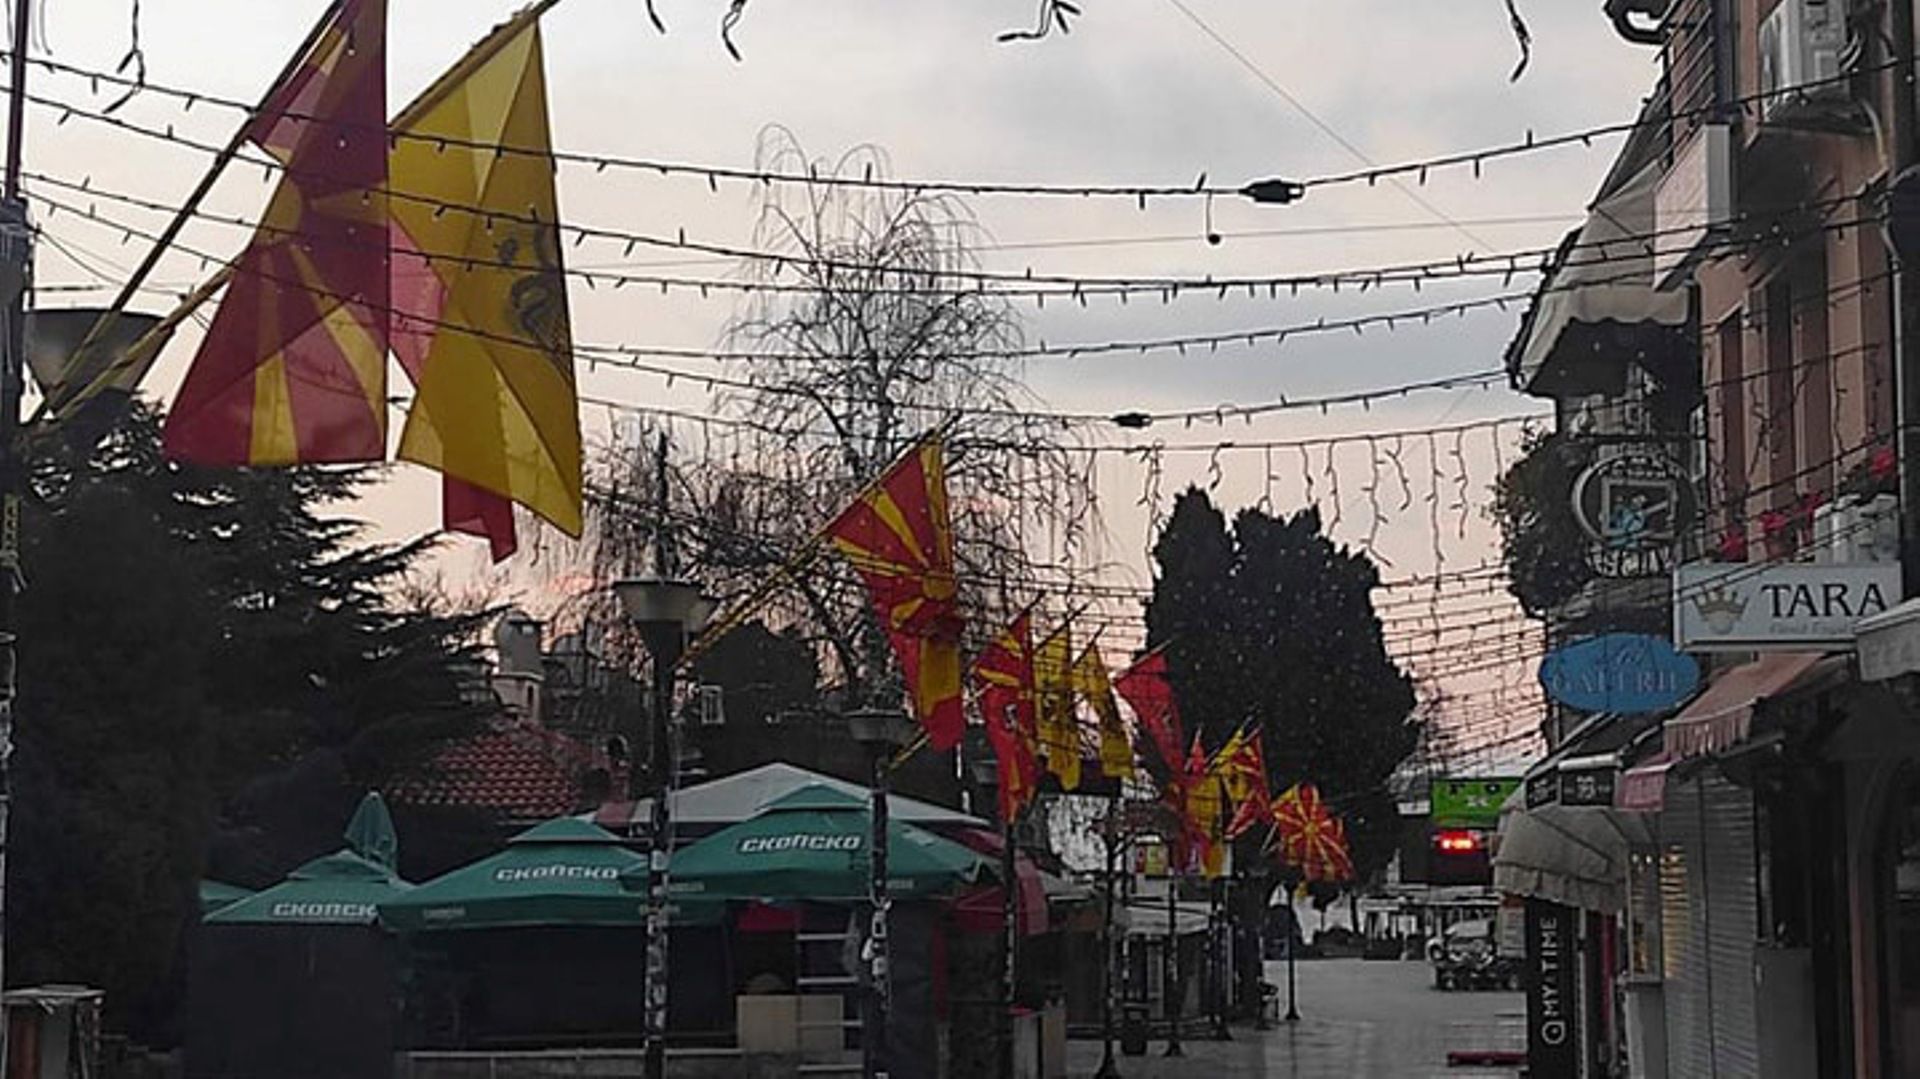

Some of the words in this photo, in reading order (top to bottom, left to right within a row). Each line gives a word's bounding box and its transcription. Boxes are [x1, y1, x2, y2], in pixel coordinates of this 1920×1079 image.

[1761, 583, 1887, 617] TARA
[272, 903, 379, 917] СКОПСК
[1541, 917, 1558, 973] TIME
[1541, 983, 1559, 1017] MY
